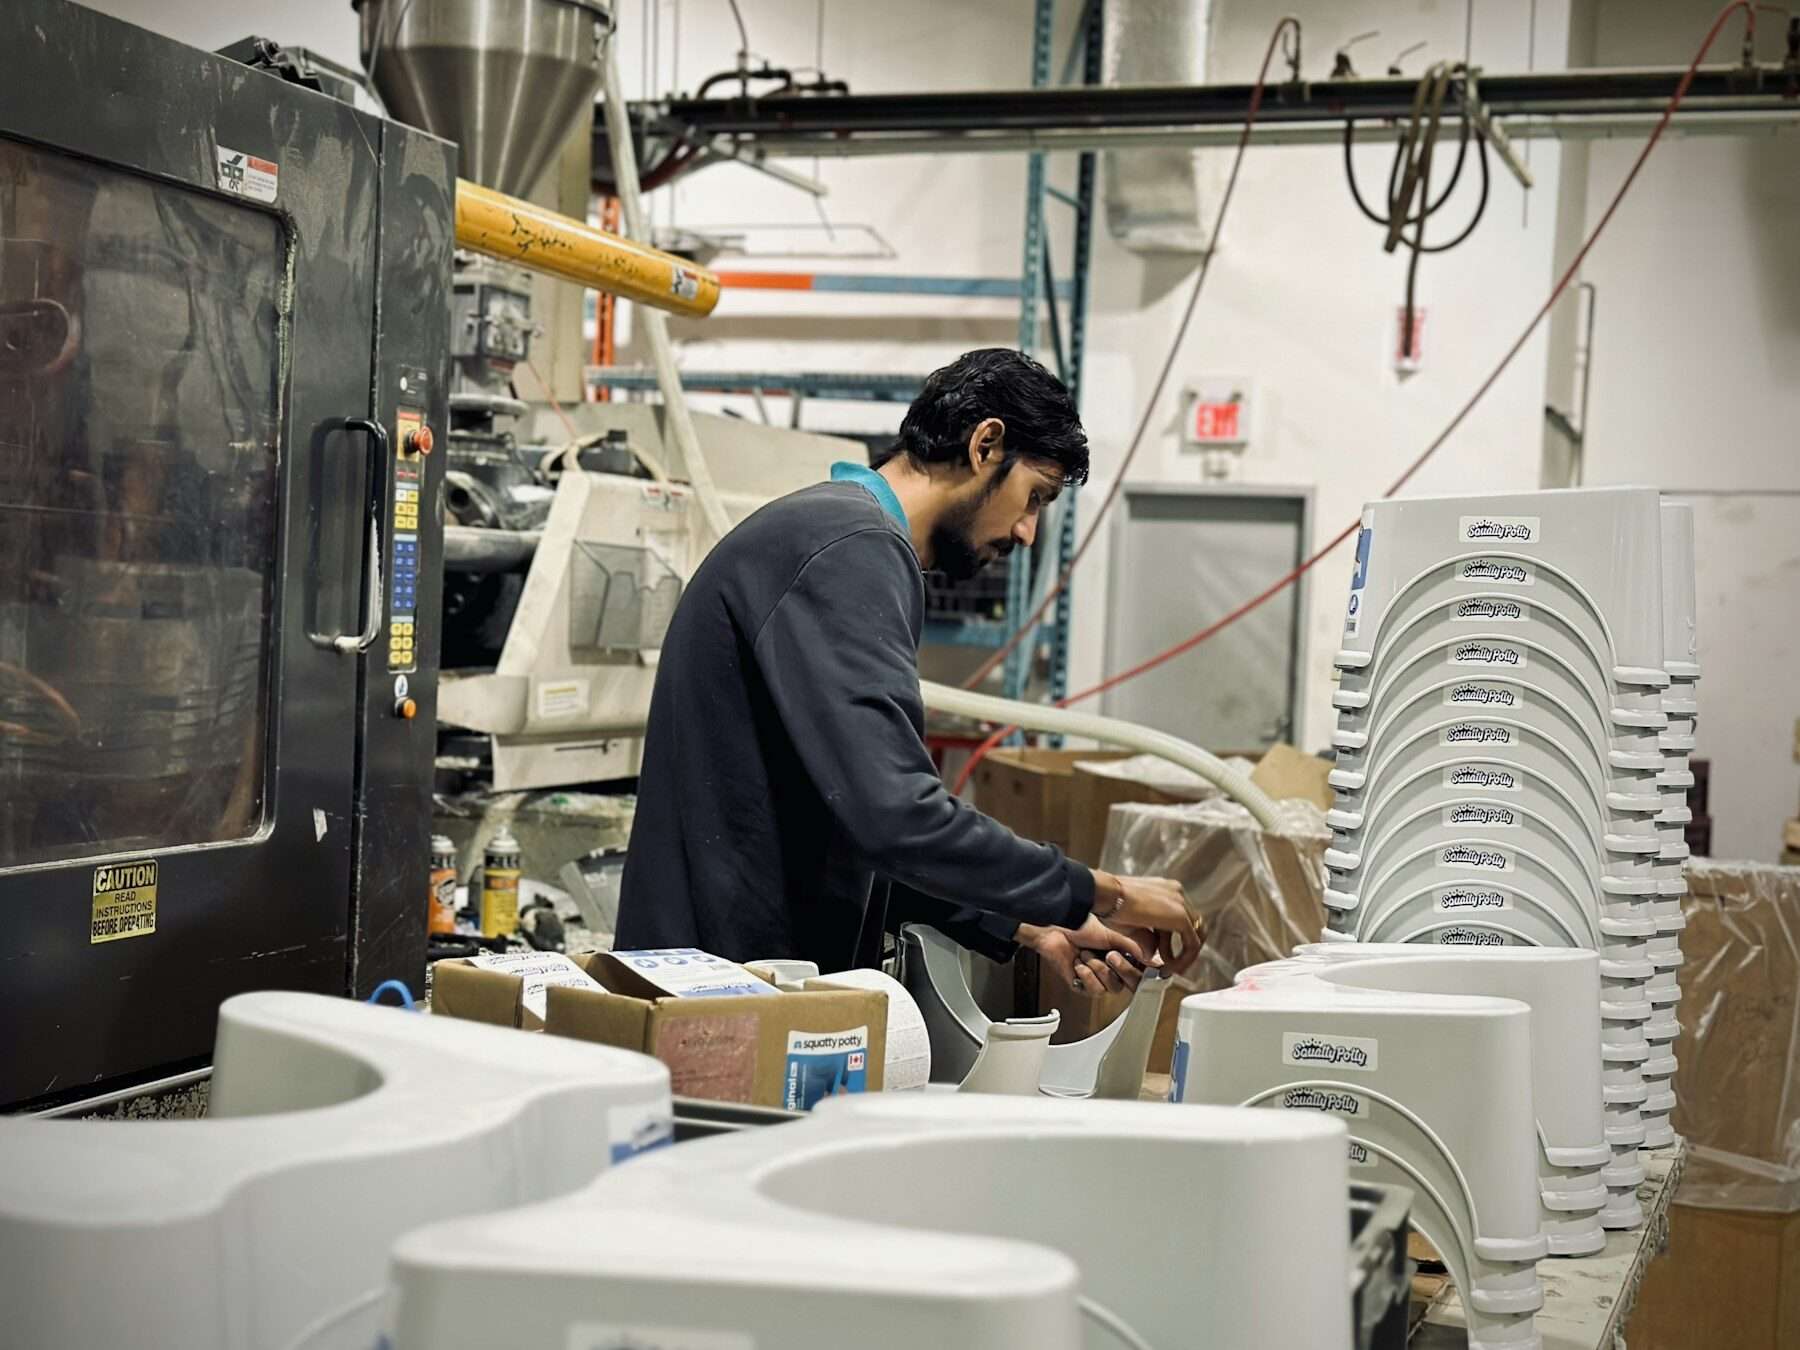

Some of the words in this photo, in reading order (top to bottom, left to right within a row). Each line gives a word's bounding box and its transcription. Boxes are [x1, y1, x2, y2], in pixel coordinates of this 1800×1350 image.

[96, 864, 155, 892] CAUTION
[114, 891, 136, 903] READ
[96, 900, 153, 918] INSTRUCTIONS
[93, 918, 118, 937] BEFORE
[119, 912, 154, 933] OPERATING
[803, 1038, 837, 1050] squatty
[838, 1035, 862, 1047] potty
[787, 1079, 798, 1112] ginal
